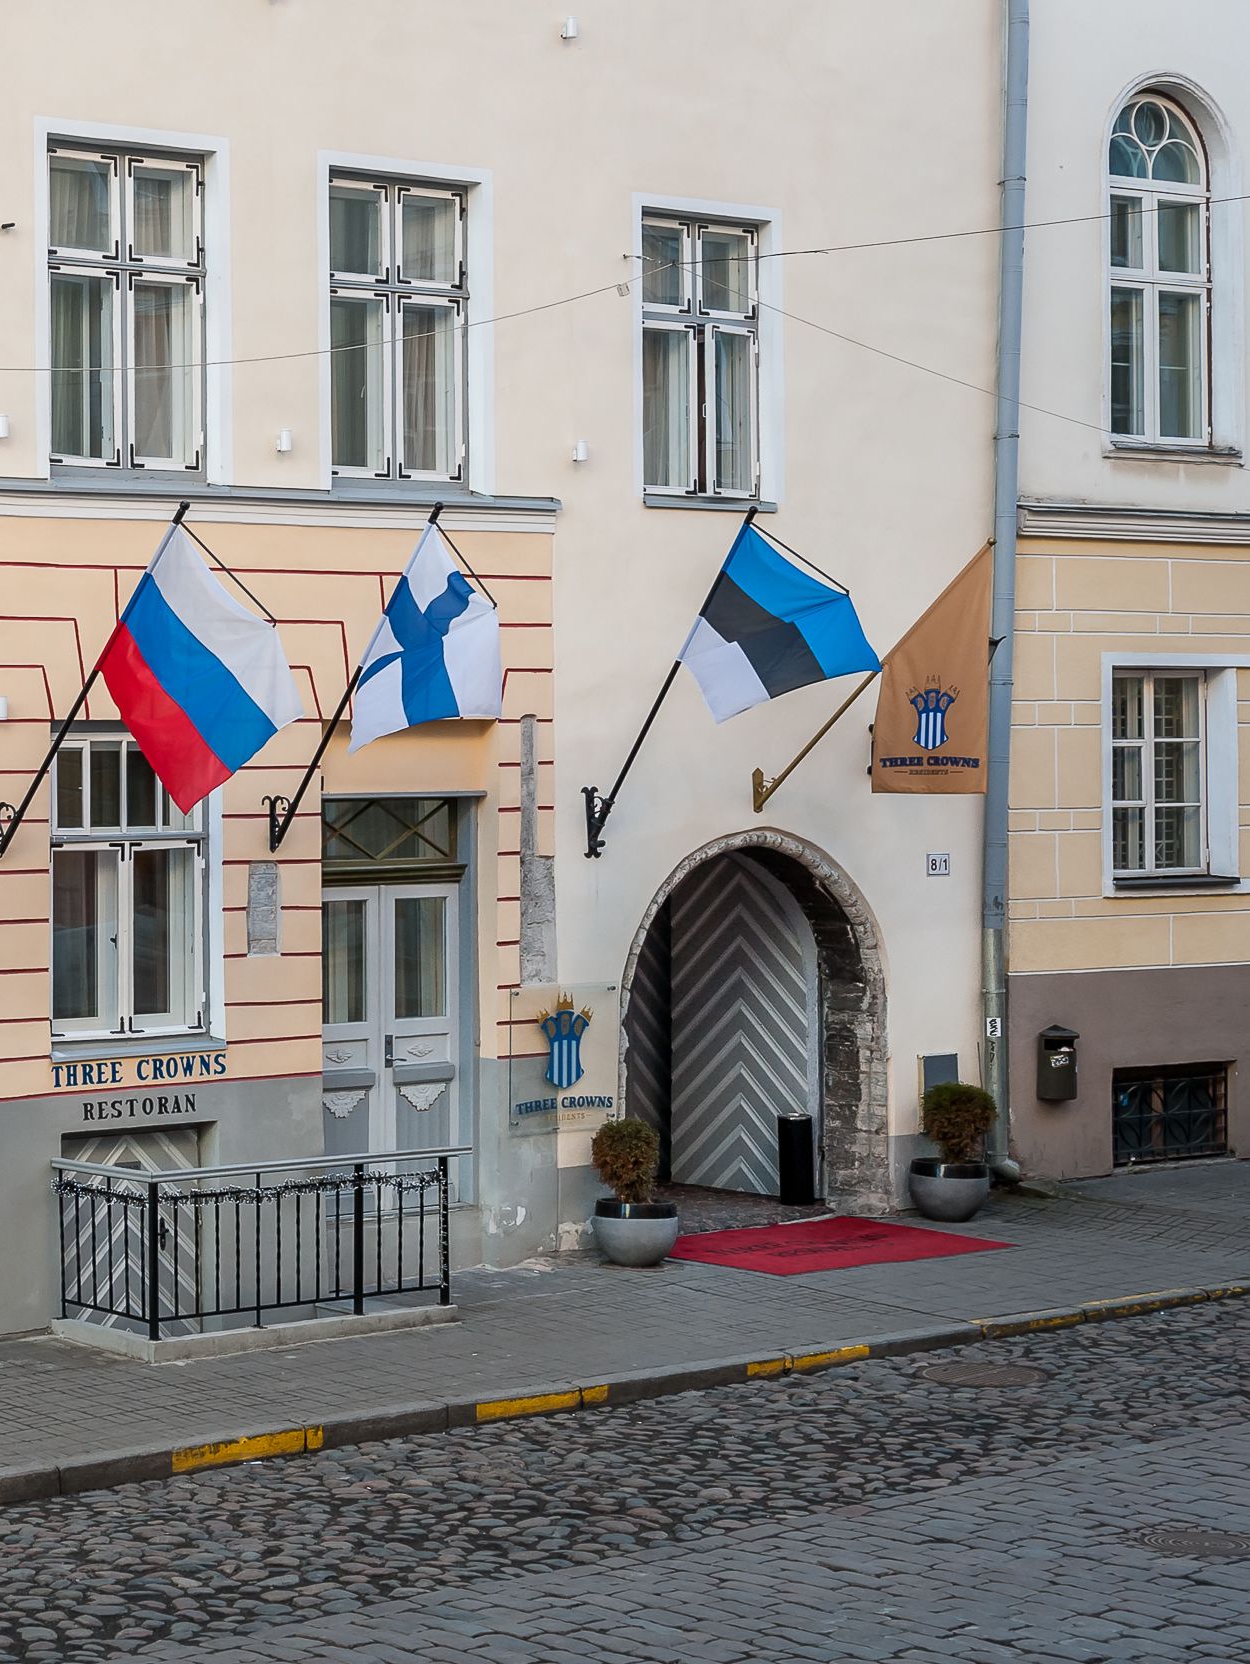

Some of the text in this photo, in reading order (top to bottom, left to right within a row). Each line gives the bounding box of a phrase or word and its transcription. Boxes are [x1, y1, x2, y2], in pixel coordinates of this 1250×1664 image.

[879, 756, 980, 768] THREE CROWNS
[930, 858, 948, 872] 8/1
[51, 1053, 227, 1088] THREE CROWNS
[82, 1093, 197, 1121] RESTORAN
[516, 1096, 614, 1115] THREE CROWNS
